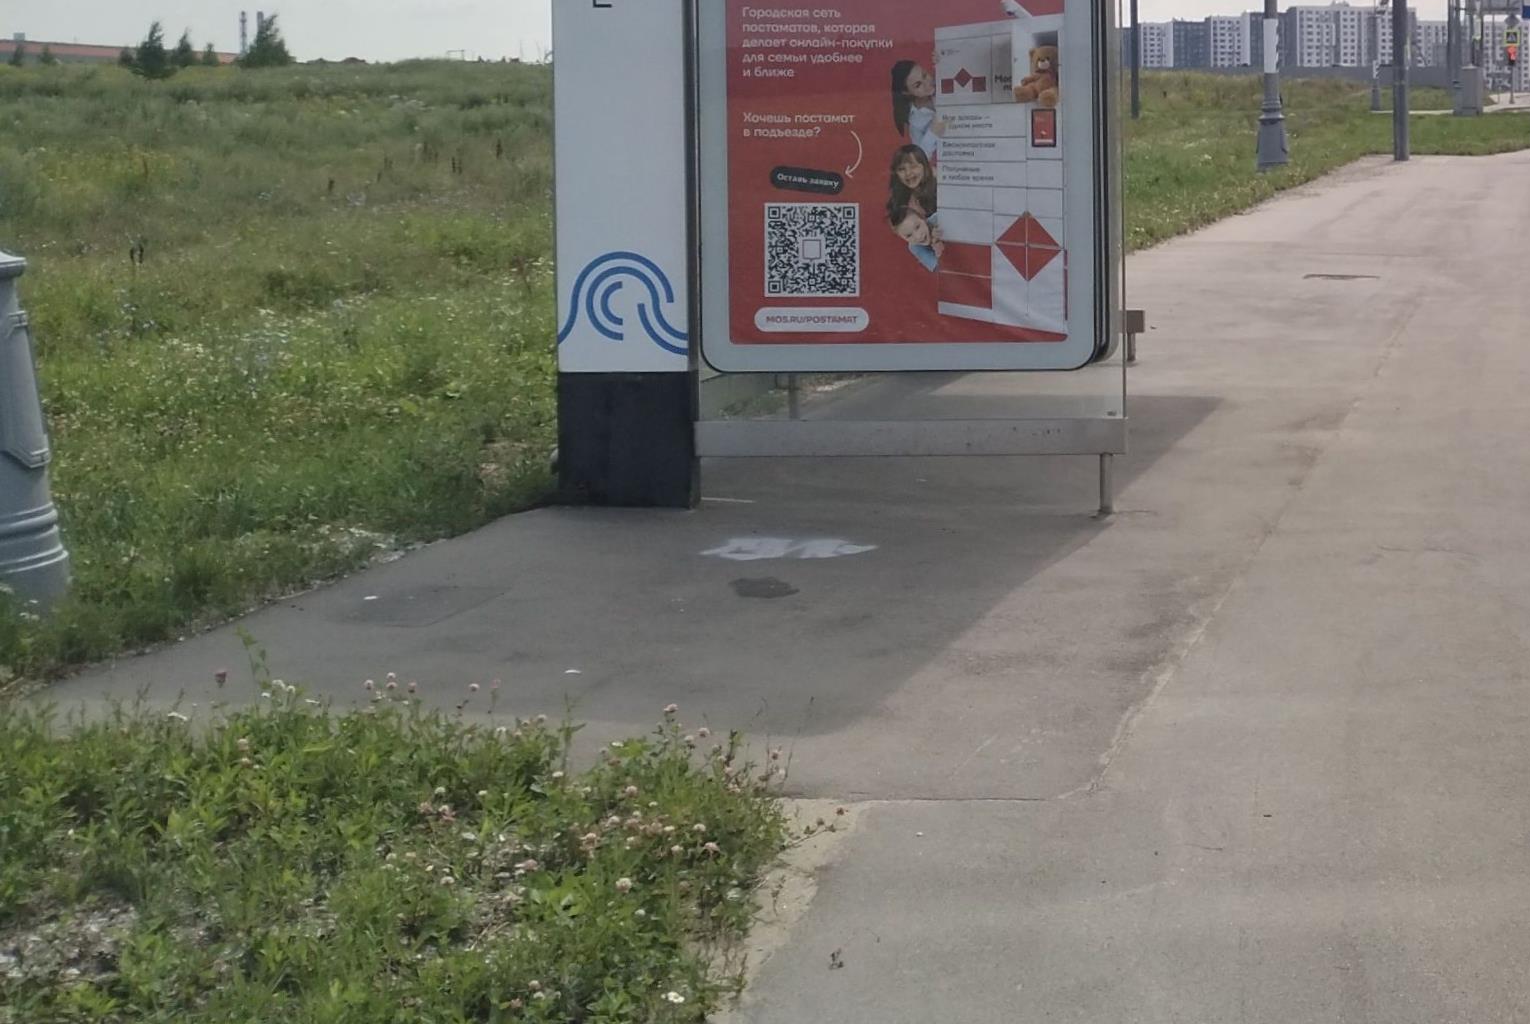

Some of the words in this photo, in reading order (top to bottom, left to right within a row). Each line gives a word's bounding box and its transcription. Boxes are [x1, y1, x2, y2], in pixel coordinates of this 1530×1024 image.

[742, 7, 810, 19] Городская
[812, 8, 841, 18] сеть
[742, 24, 821, 34] постаматов,
[823, 24, 876, 35] которая
[742, 38, 786, 48] делает
[789, 37, 894, 51] онлайн-покупки
[742, 53, 765, 63] для
[767, 53, 807, 63] семьи
[810, 52, 864, 65] удобнее
[742, 68, 751, 77] и
[753, 66, 795, 78] ближе
[742, 112, 792, 124] Хочешь
[794, 114, 856, 124] постамат
[743, 128, 751, 137] в
[753, 126, 822, 138] подъезде?
